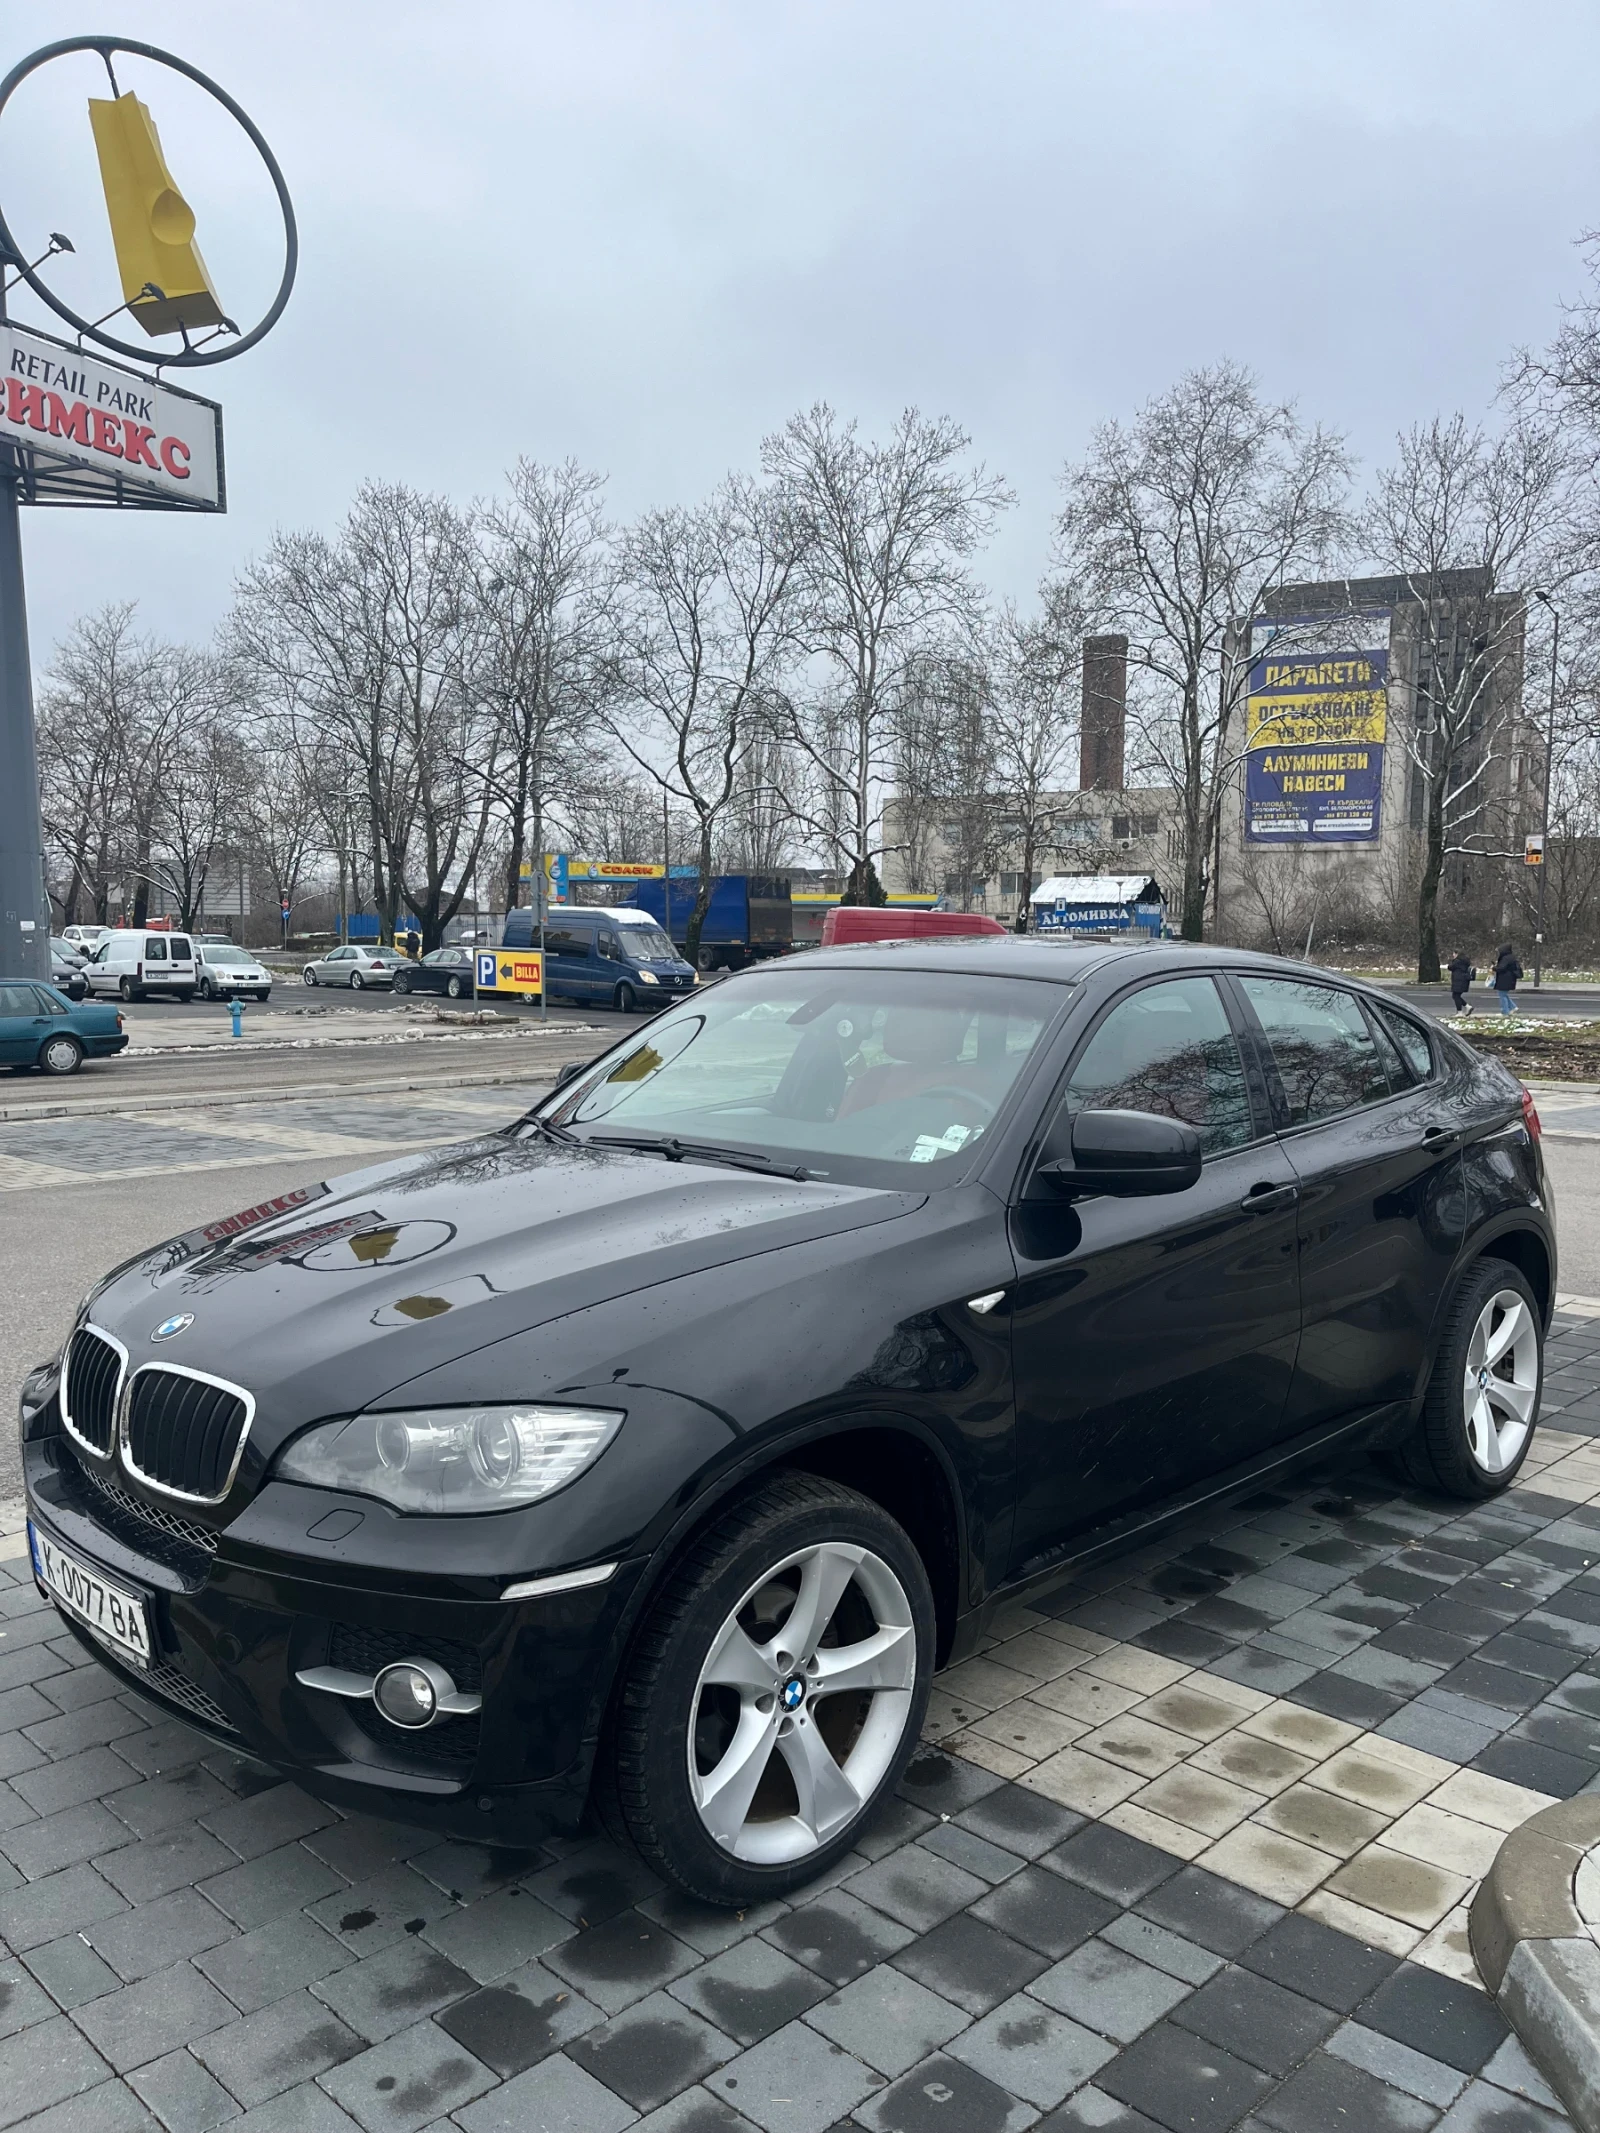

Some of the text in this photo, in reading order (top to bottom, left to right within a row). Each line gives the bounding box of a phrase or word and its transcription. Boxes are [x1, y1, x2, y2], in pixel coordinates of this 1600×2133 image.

[11, 348, 153, 422] RETAIL PARK
[0, 377, 190, 479] ИМЕКС
[1266, 661, 1371, 687] ПАРАПЕТИ
[1263, 753, 1368, 772] АЛУМИНИЕВИ
[1283, 774, 1346, 793] НАВЕСИ
[481, 956, 539, 984] P BILLA
